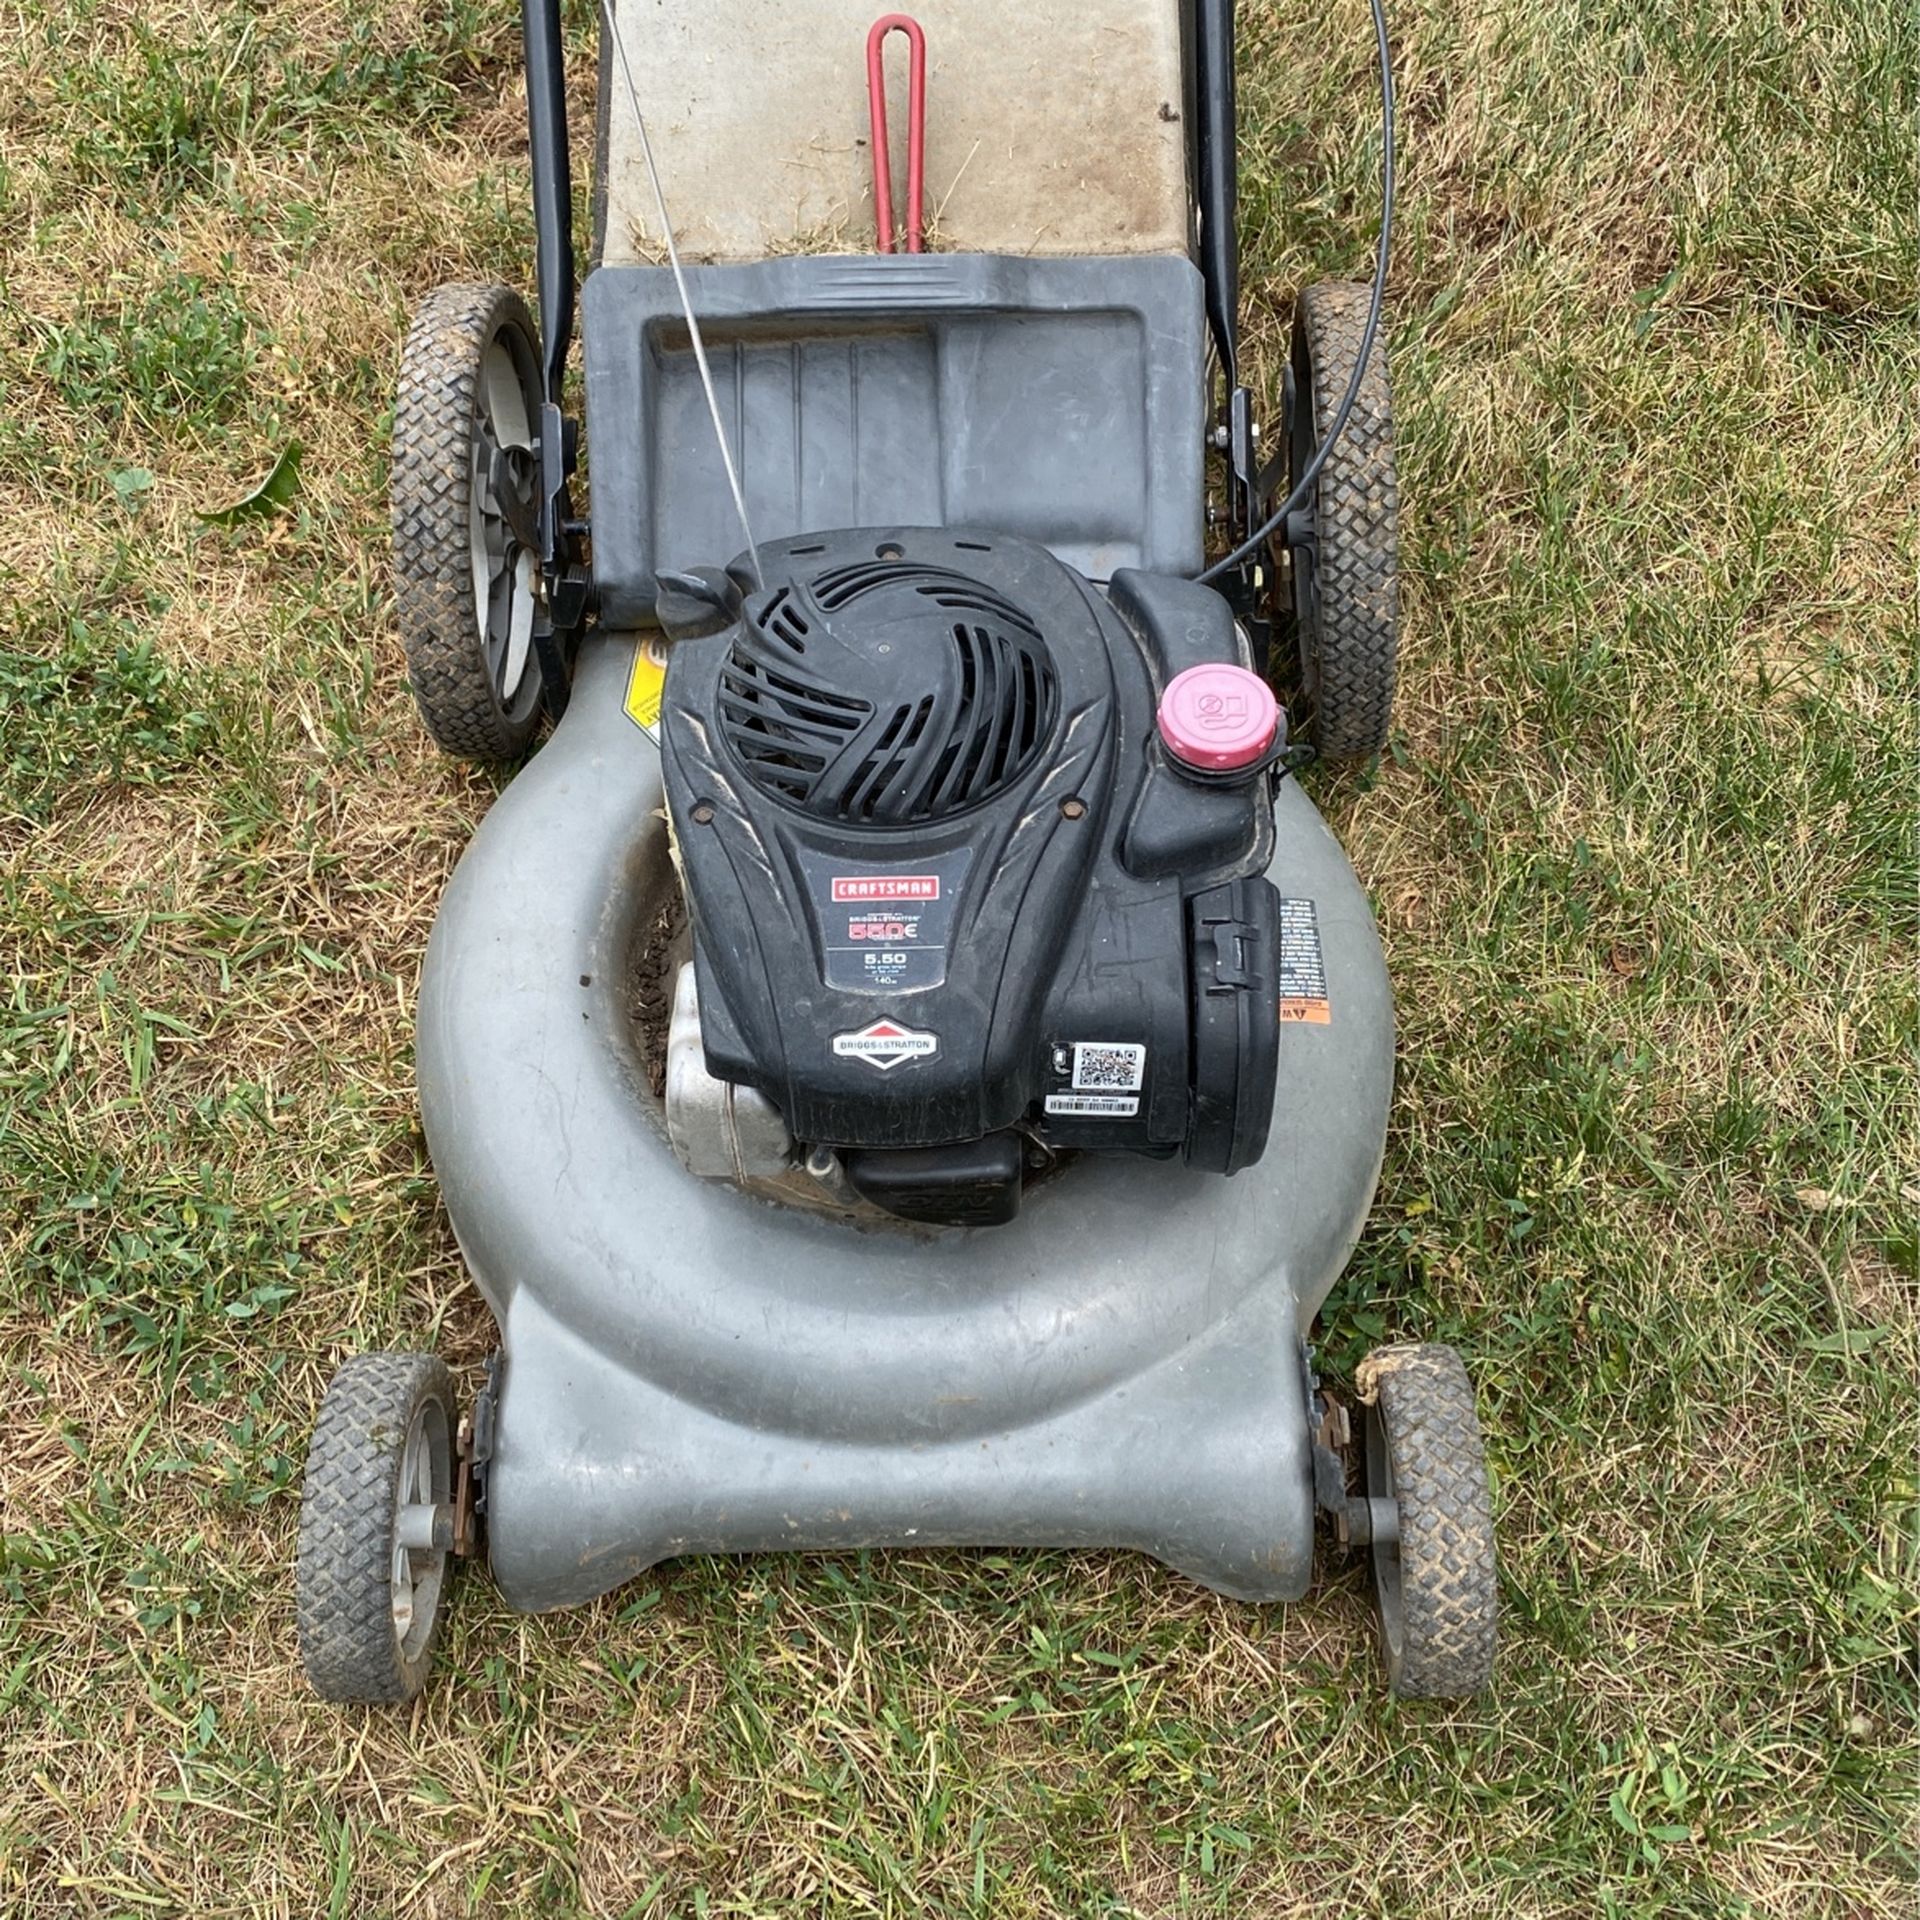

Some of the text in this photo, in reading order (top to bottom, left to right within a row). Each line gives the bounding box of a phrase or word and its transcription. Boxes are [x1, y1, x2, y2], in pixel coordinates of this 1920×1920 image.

[838, 881, 932, 896] CRAFTSMAN
[865, 953, 907, 965] 5.50
[840, 1040, 930, 1049] BRIGGS&STRATTON
